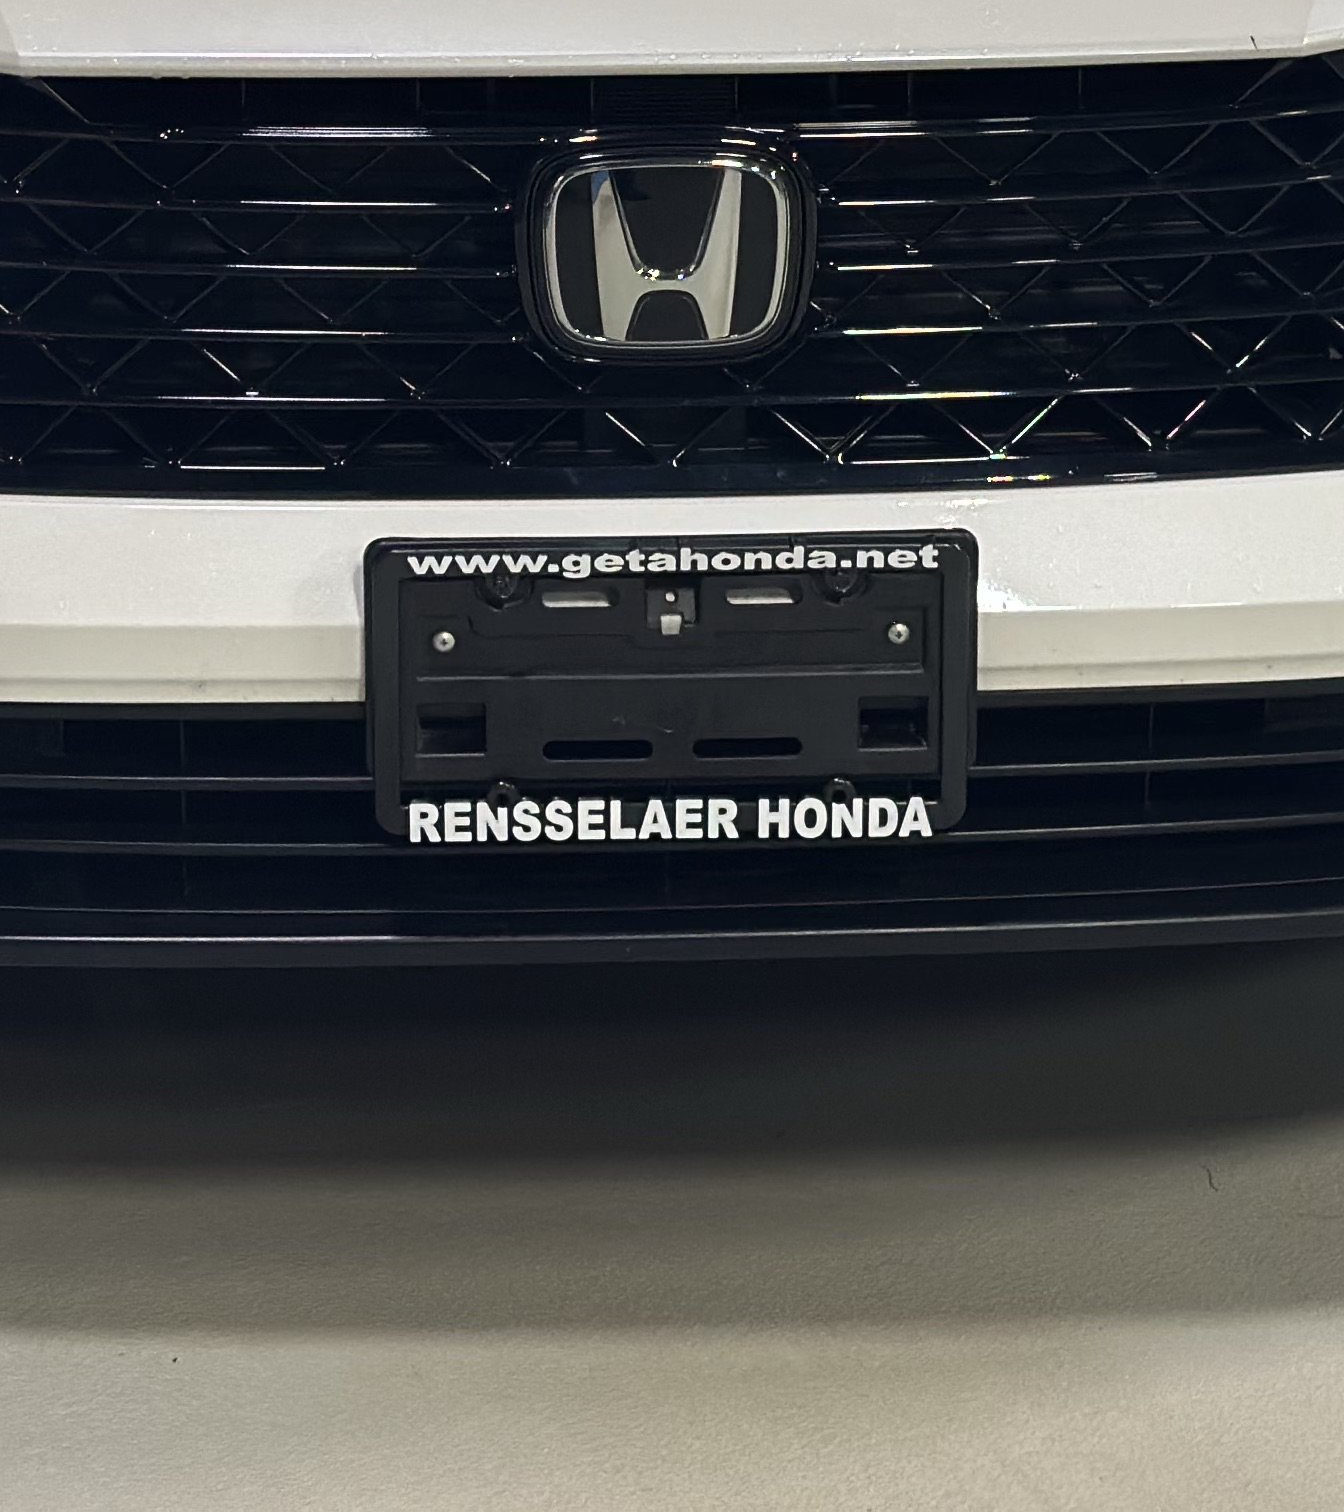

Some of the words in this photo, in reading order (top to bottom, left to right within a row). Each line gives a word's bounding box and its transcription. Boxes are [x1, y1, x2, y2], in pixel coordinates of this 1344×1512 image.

[407, 544, 939, 578] www.getahonda.net
[409, 798, 739, 843] RENSSELAER
[757, 796, 933, 839] HONDA
